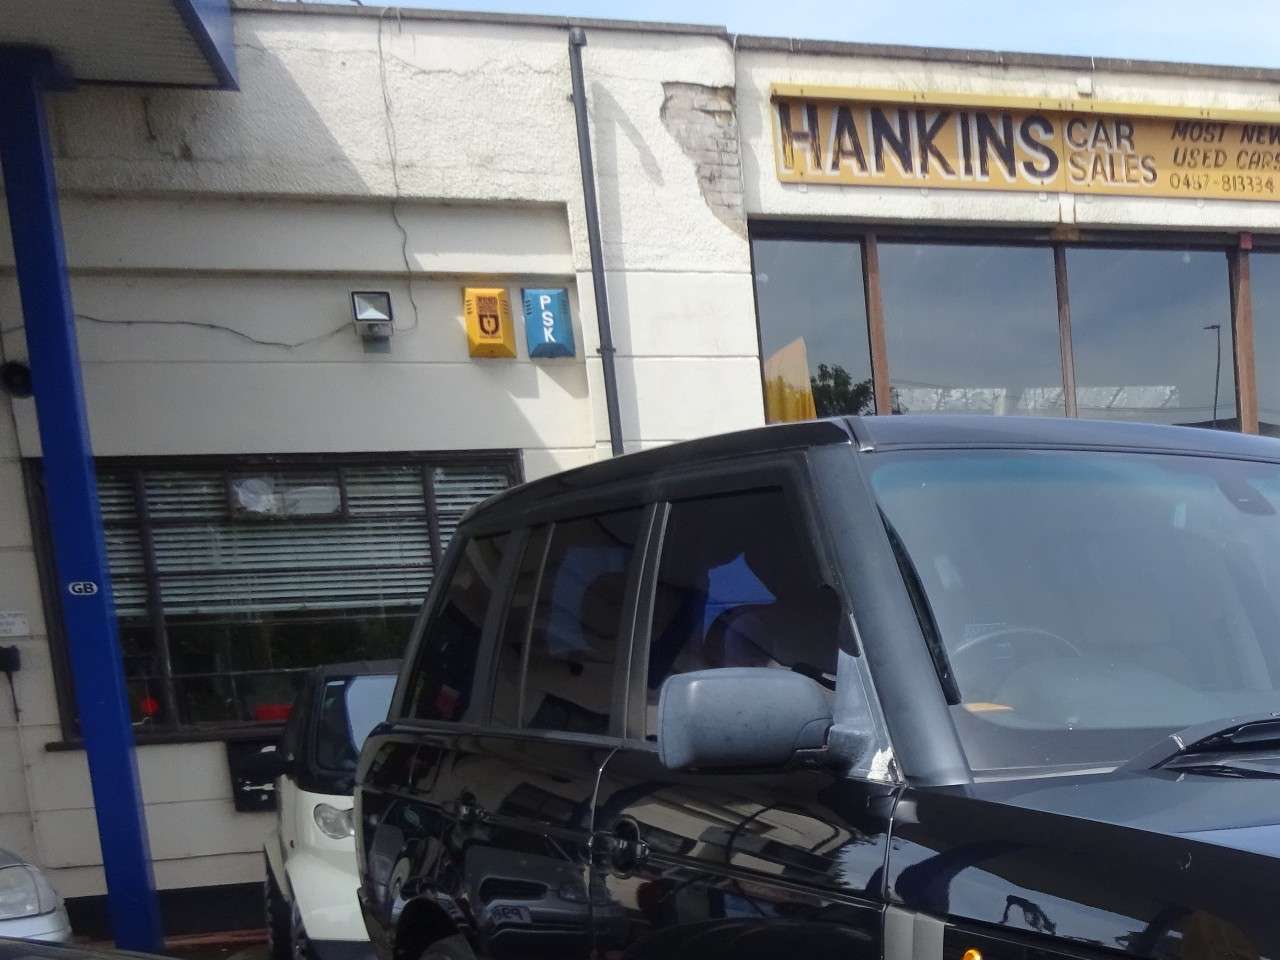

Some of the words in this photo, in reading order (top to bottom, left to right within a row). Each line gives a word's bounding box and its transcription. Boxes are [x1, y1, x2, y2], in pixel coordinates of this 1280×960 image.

[777, 101, 1060, 180] HANKINS
[1066, 118, 1136, 151] CAR
[1170, 121, 1227, 143] MOST
[1069, 152, 1159, 184] SALES
[1172, 147, 1228, 169] USED
[70, 583, 95, 594] GB
